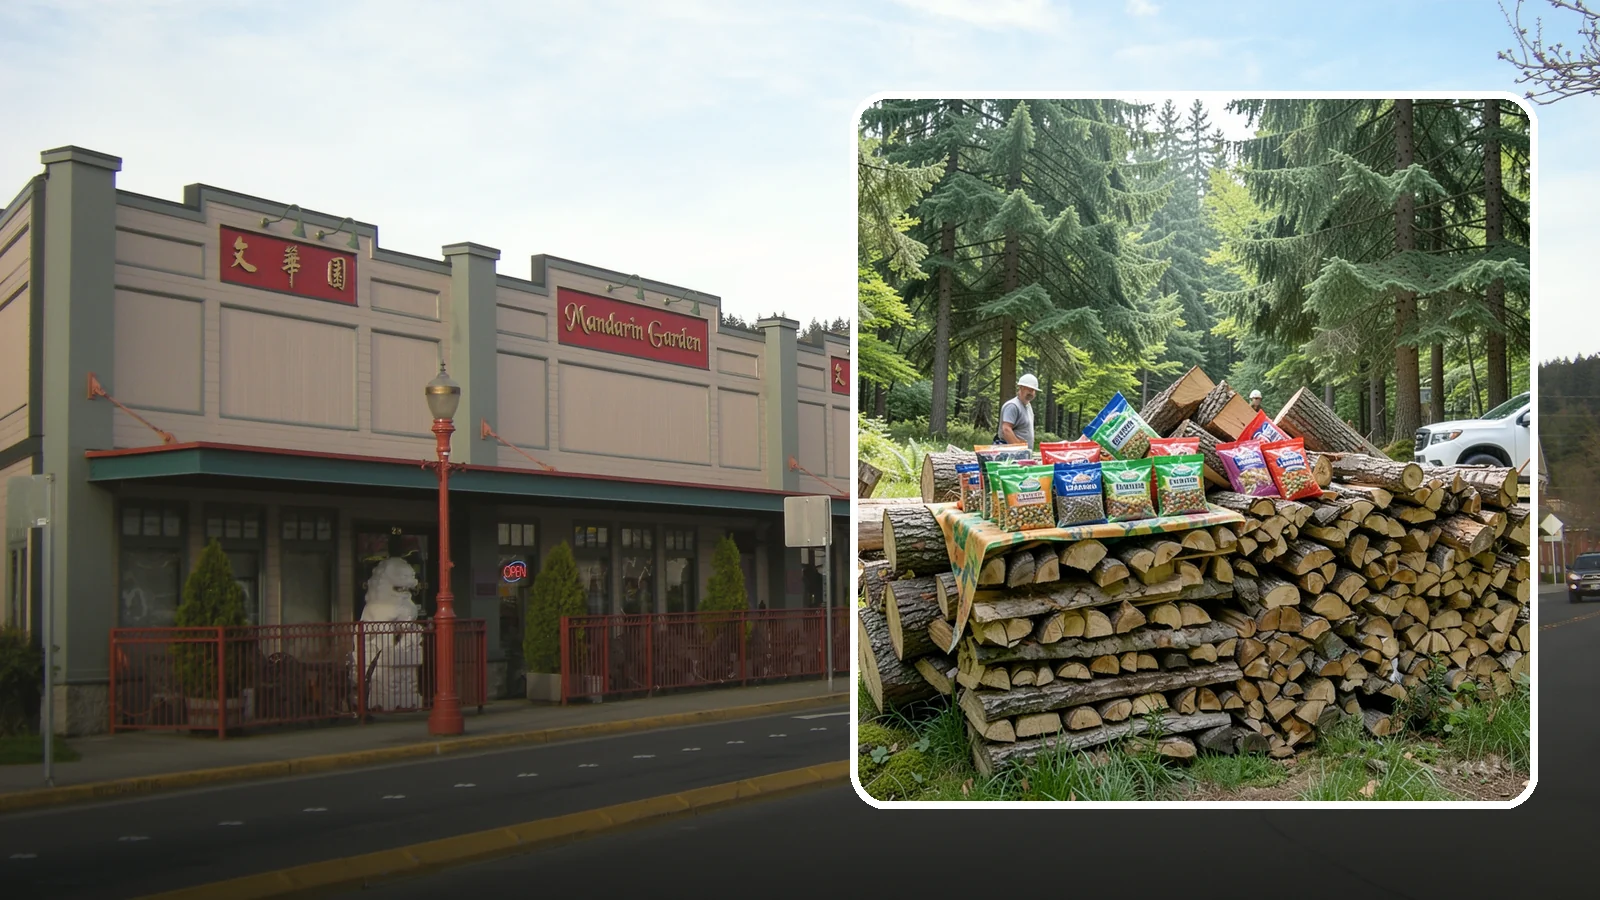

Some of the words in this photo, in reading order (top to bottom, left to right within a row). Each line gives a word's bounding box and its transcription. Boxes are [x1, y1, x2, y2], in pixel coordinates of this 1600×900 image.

[230, 235, 346, 291] 文華園
[564, 302, 644, 341] Mandarin
[647, 319, 702, 353] Garden
[503, 565, 527, 578] OPEN
